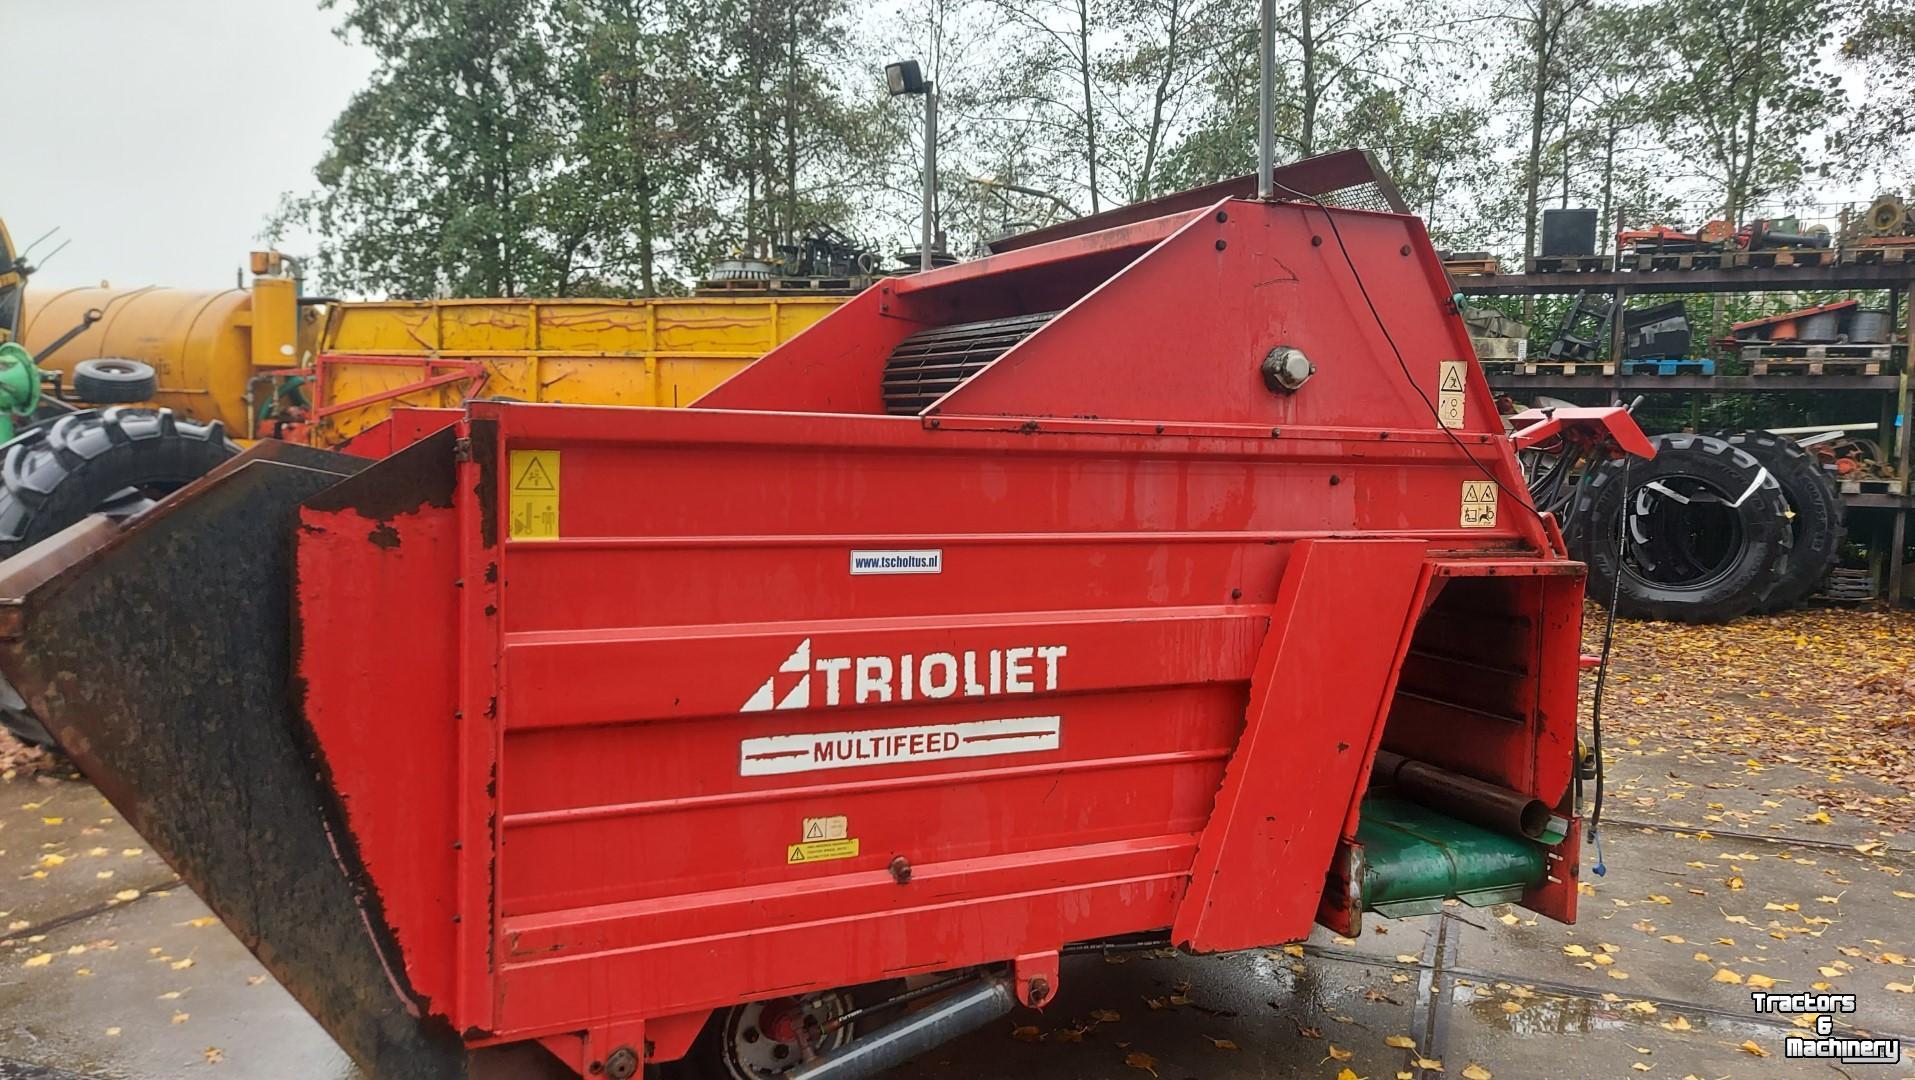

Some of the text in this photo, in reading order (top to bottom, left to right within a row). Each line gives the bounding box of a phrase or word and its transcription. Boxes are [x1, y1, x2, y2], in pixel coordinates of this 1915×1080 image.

[855, 555, 938, 568] www.tscholtus.nl
[816, 645, 1067, 706] TRIOLIET
[814, 732, 960, 762] MULTIFEED
